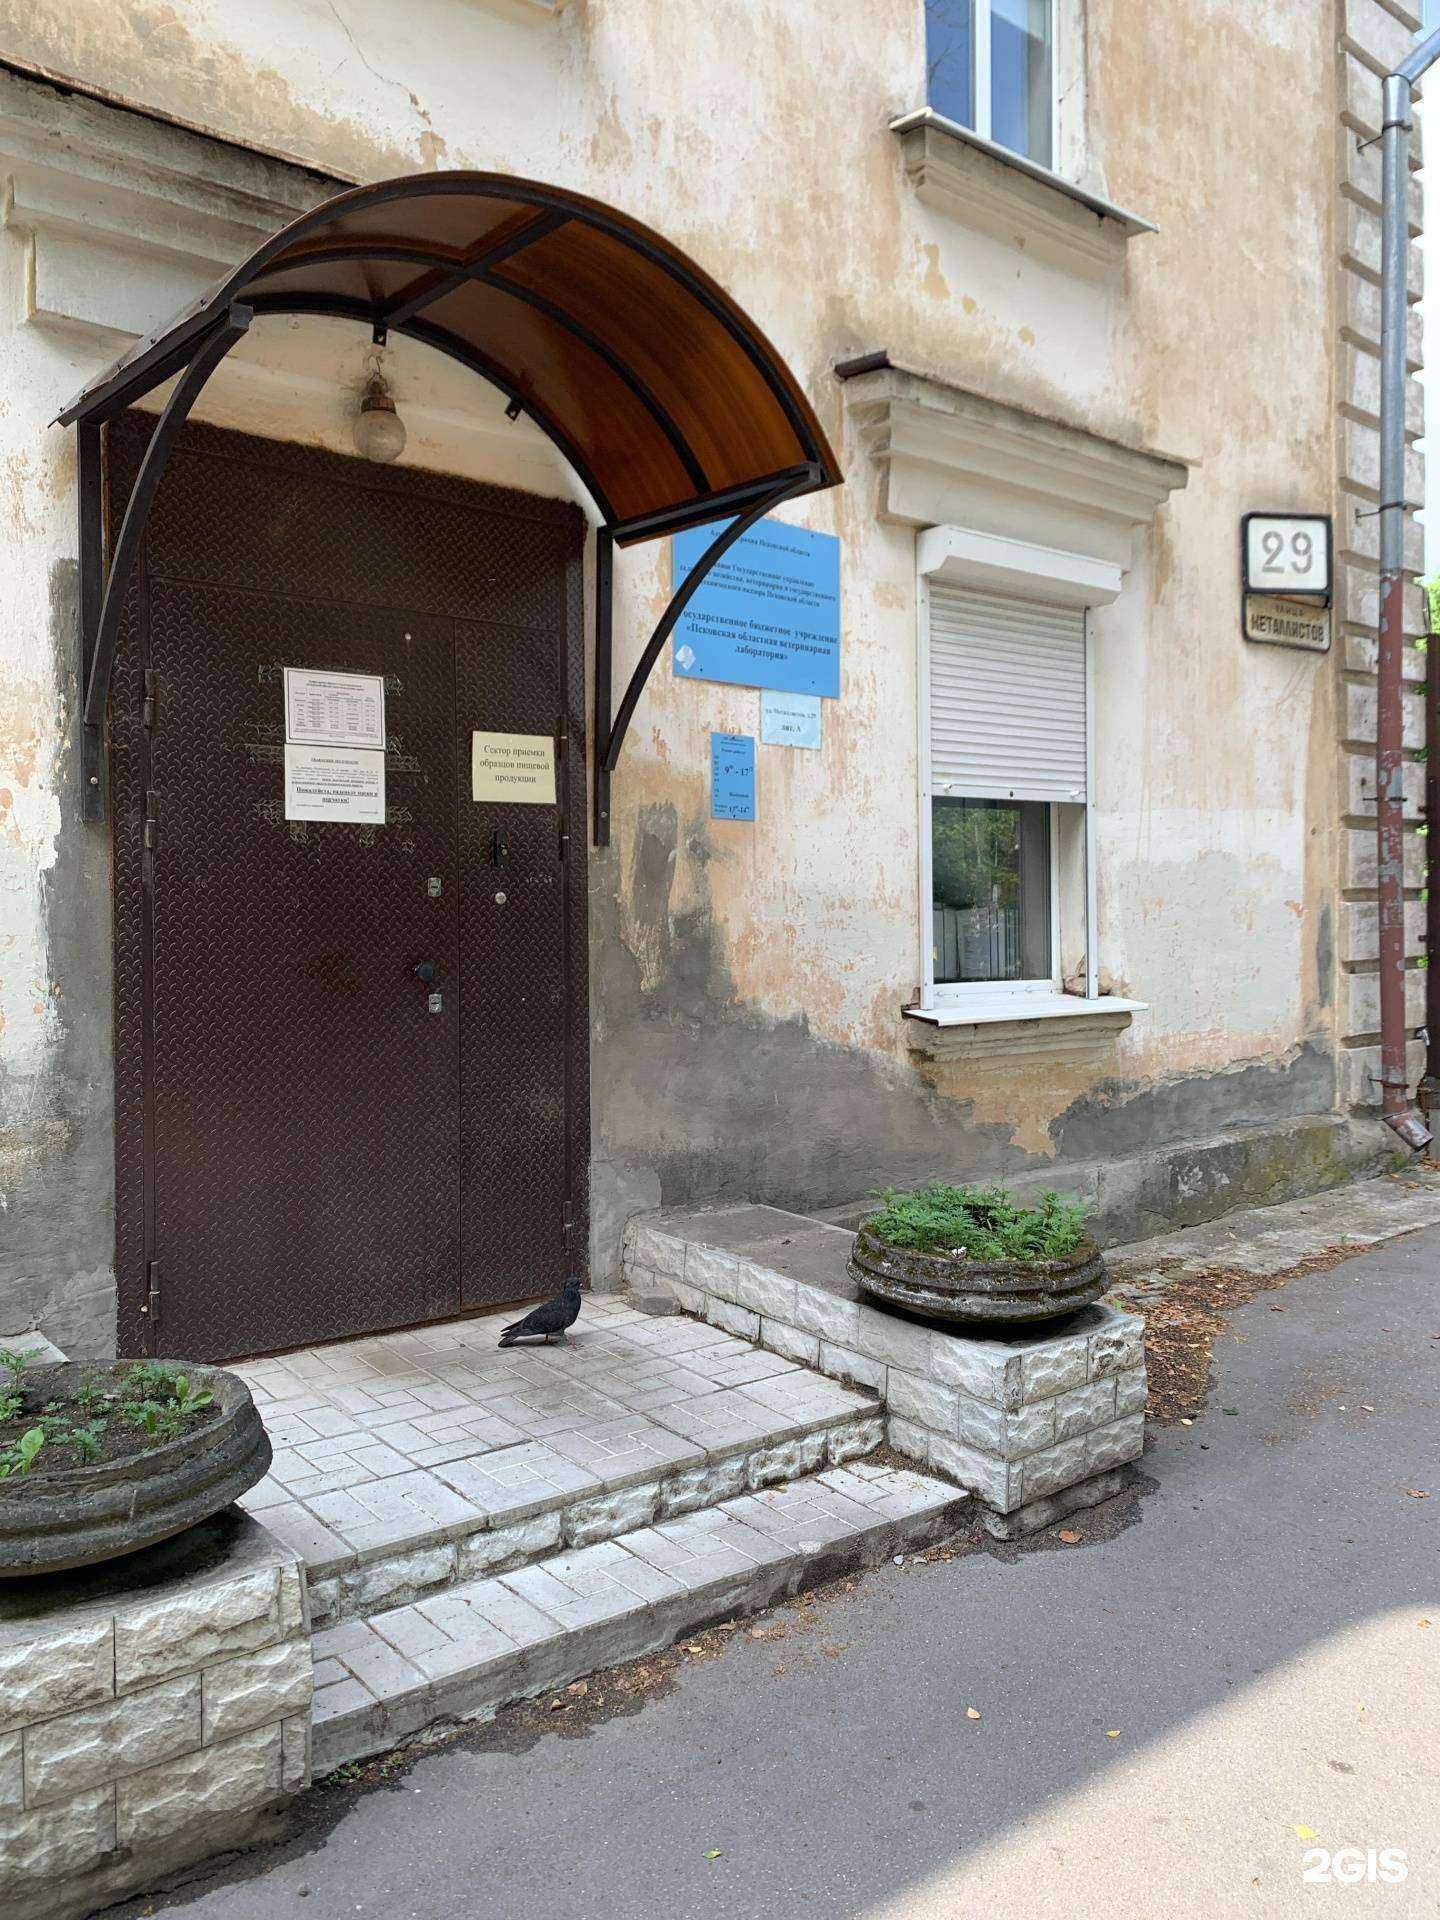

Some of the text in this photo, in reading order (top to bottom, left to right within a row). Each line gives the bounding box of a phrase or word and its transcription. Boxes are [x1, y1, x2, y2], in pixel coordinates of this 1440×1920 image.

[1262, 530, 1312, 574] 29
[683, 610, 838, 644] осударственное бюджетное учреждение
[1250, 613, 1325, 642] МЕТАЛЛИСТОВ
[687, 623, 831, 655] «Псковская областная ветеринарная
[735, 645, 788, 660] лаборатория»
[484, 744, 545, 757] Сектор приемки
[480, 759, 550, 770] образцов пищевой
[495, 775, 537, 784] продукции
